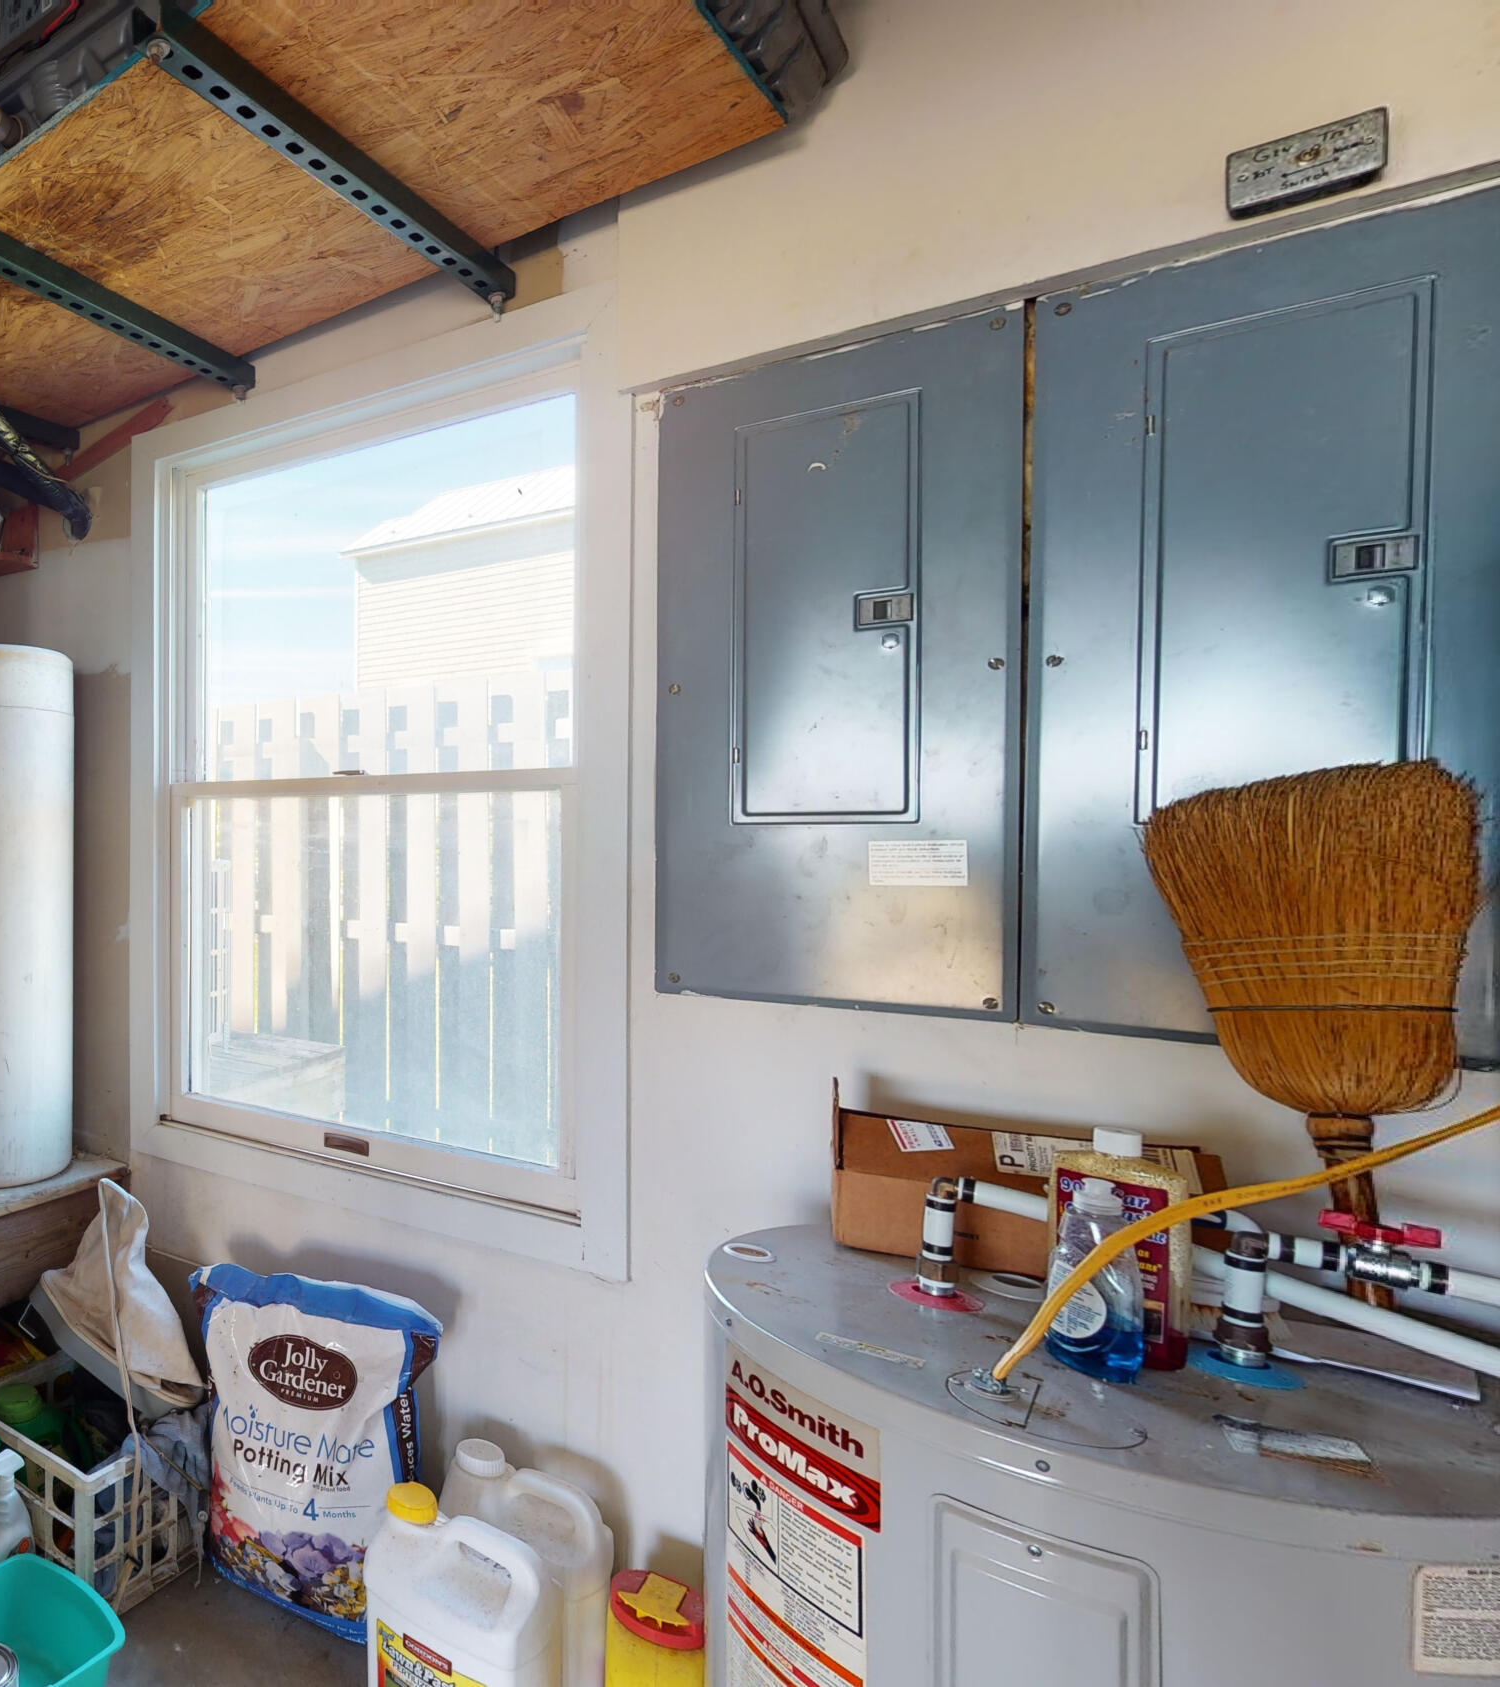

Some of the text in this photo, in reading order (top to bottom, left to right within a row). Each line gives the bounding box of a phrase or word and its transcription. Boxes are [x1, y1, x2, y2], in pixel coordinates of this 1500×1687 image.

[1026, 1141, 1038, 1172] PRIORITY
[281, 1342, 329, 1377] Jolly
[259, 1360, 346, 1399] Gardener
[280, 1388, 319, 1403] PREMIUM
[731, 1360, 864, 1460] A.O.Smith
[233, 1439, 349, 1487] Potting Mix
[732, 1402, 857, 1509] ProMax
[274, 1499, 286, 1511] Up
[288, 1504, 299, 1514] To
[302, 1498, 319, 1521] 4
[322, 1509, 357, 1519] Months
[768, 1480, 805, 1512] DANGER
